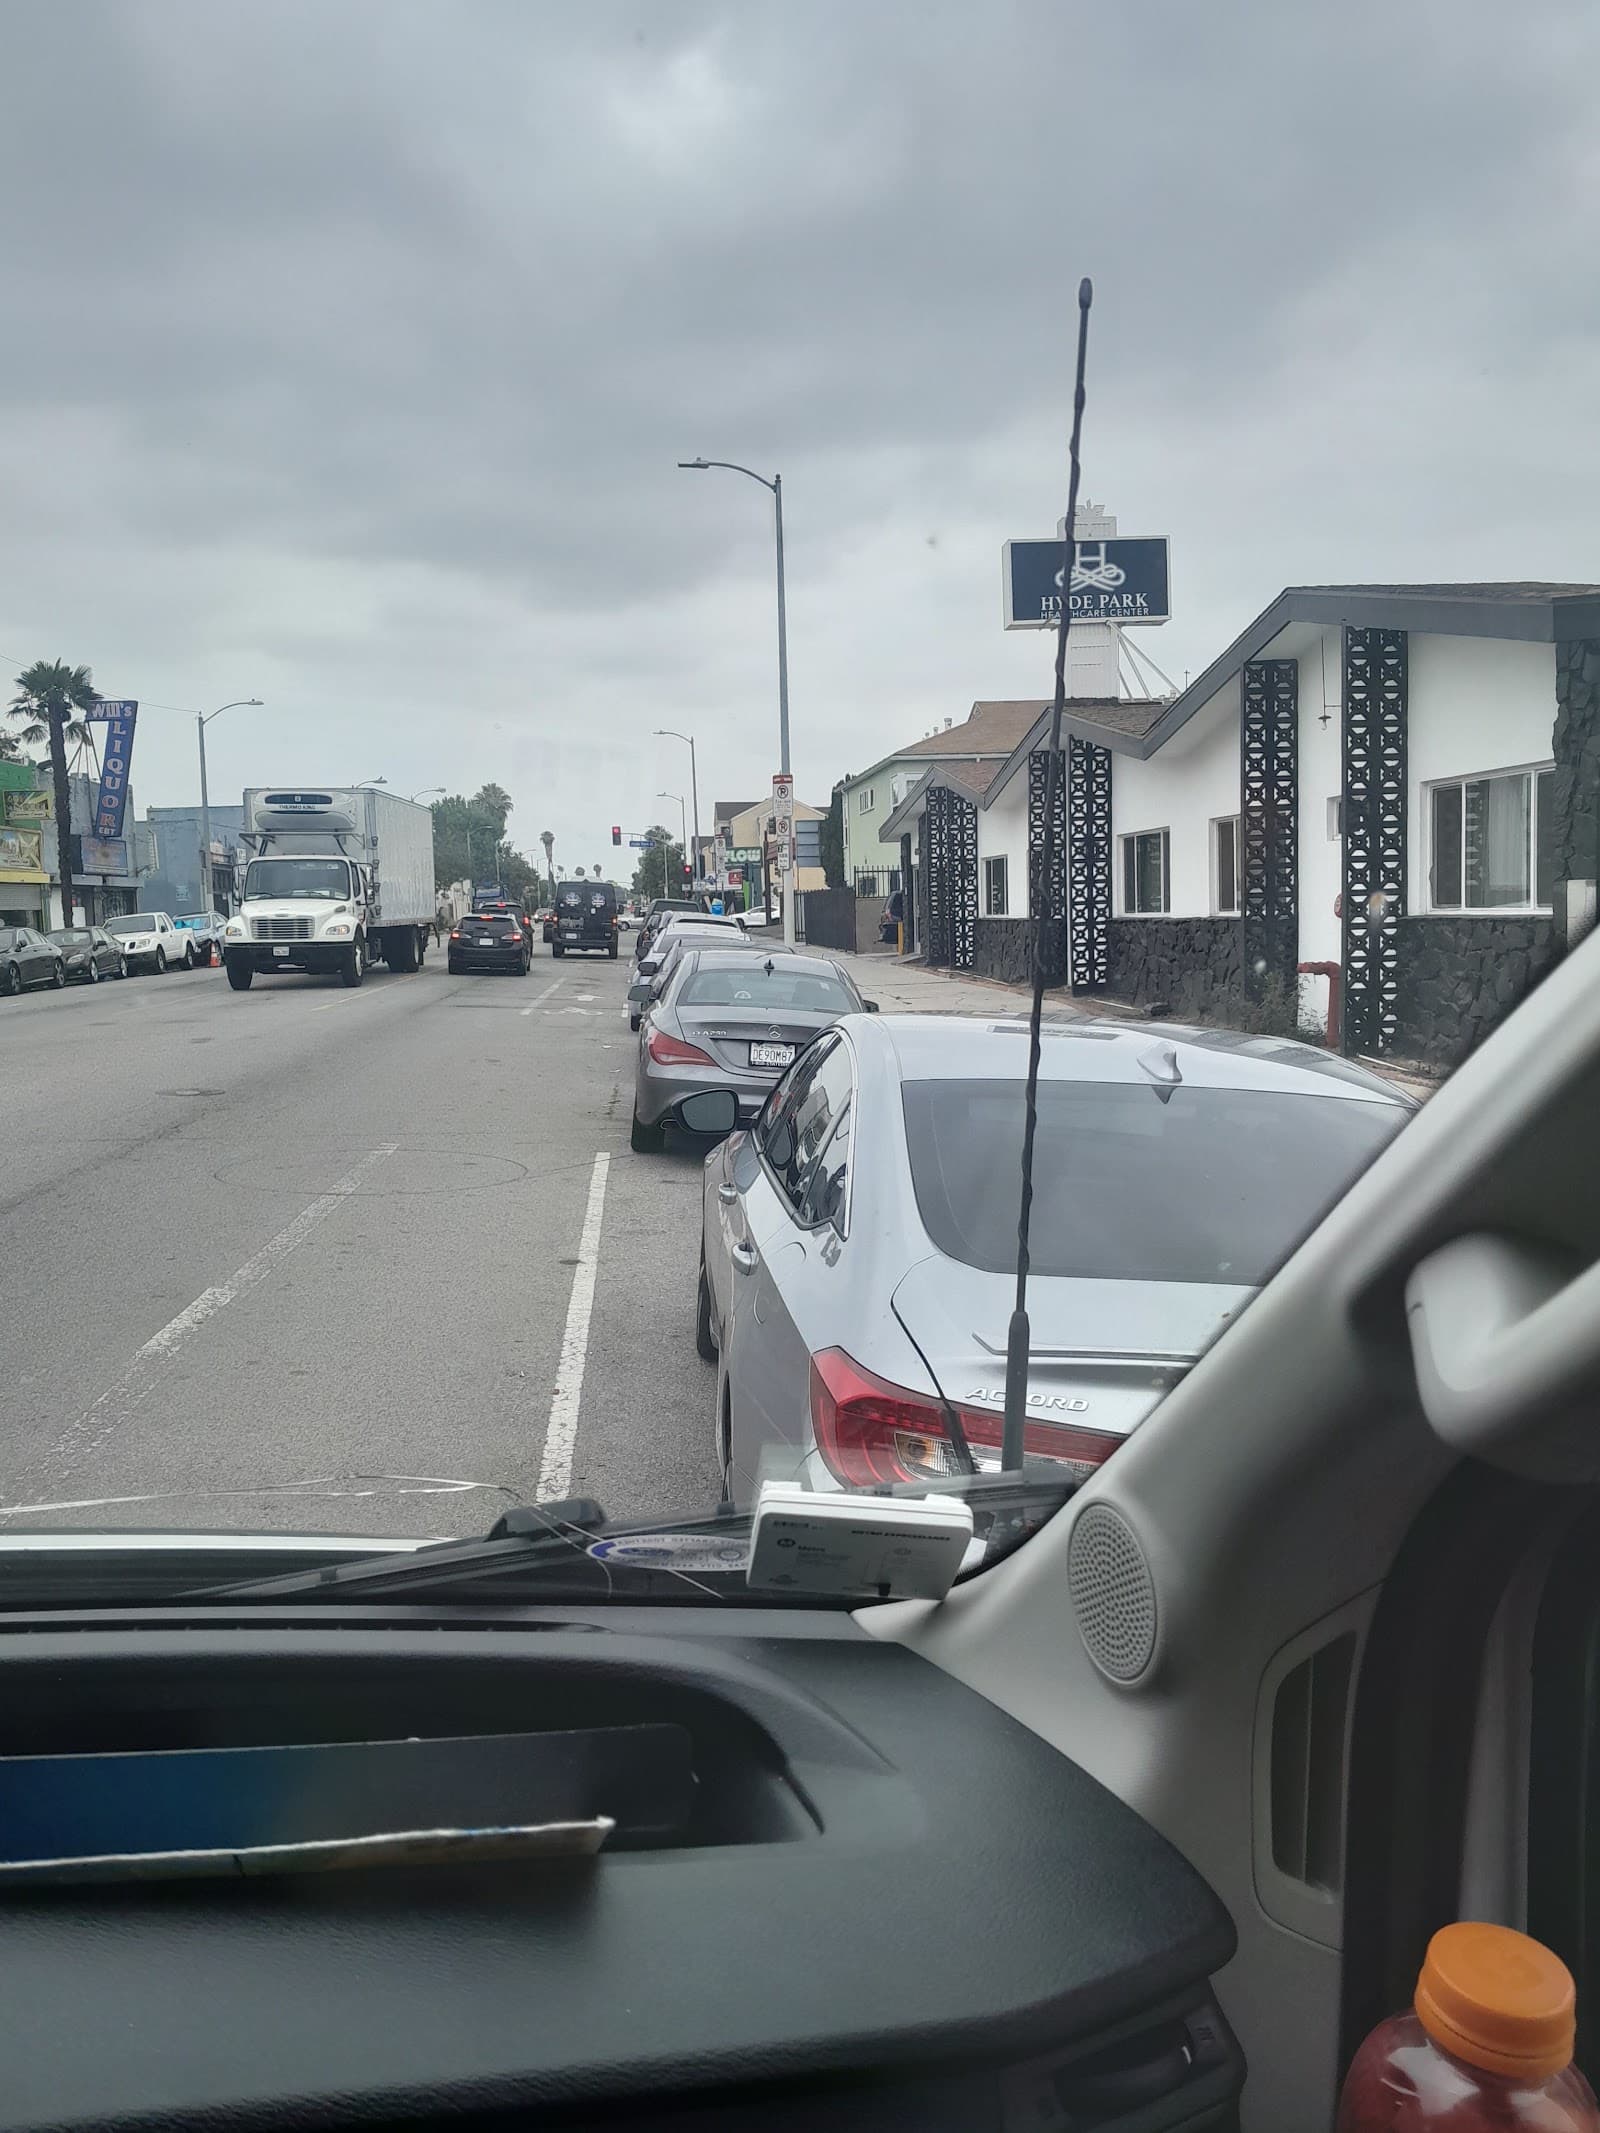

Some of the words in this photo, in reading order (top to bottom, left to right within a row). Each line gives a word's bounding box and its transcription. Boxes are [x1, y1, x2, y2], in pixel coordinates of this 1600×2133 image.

[1041, 595, 1093, 611] HYDE
[1100, 593, 1148, 609] PARK
[1041, 609, 1105, 619] HEAHCARE
[1110, 607, 1149, 616] CENTER
[100, 721, 126, 827] LIQUOR
[965, 1387, 1089, 1411] ACORD
